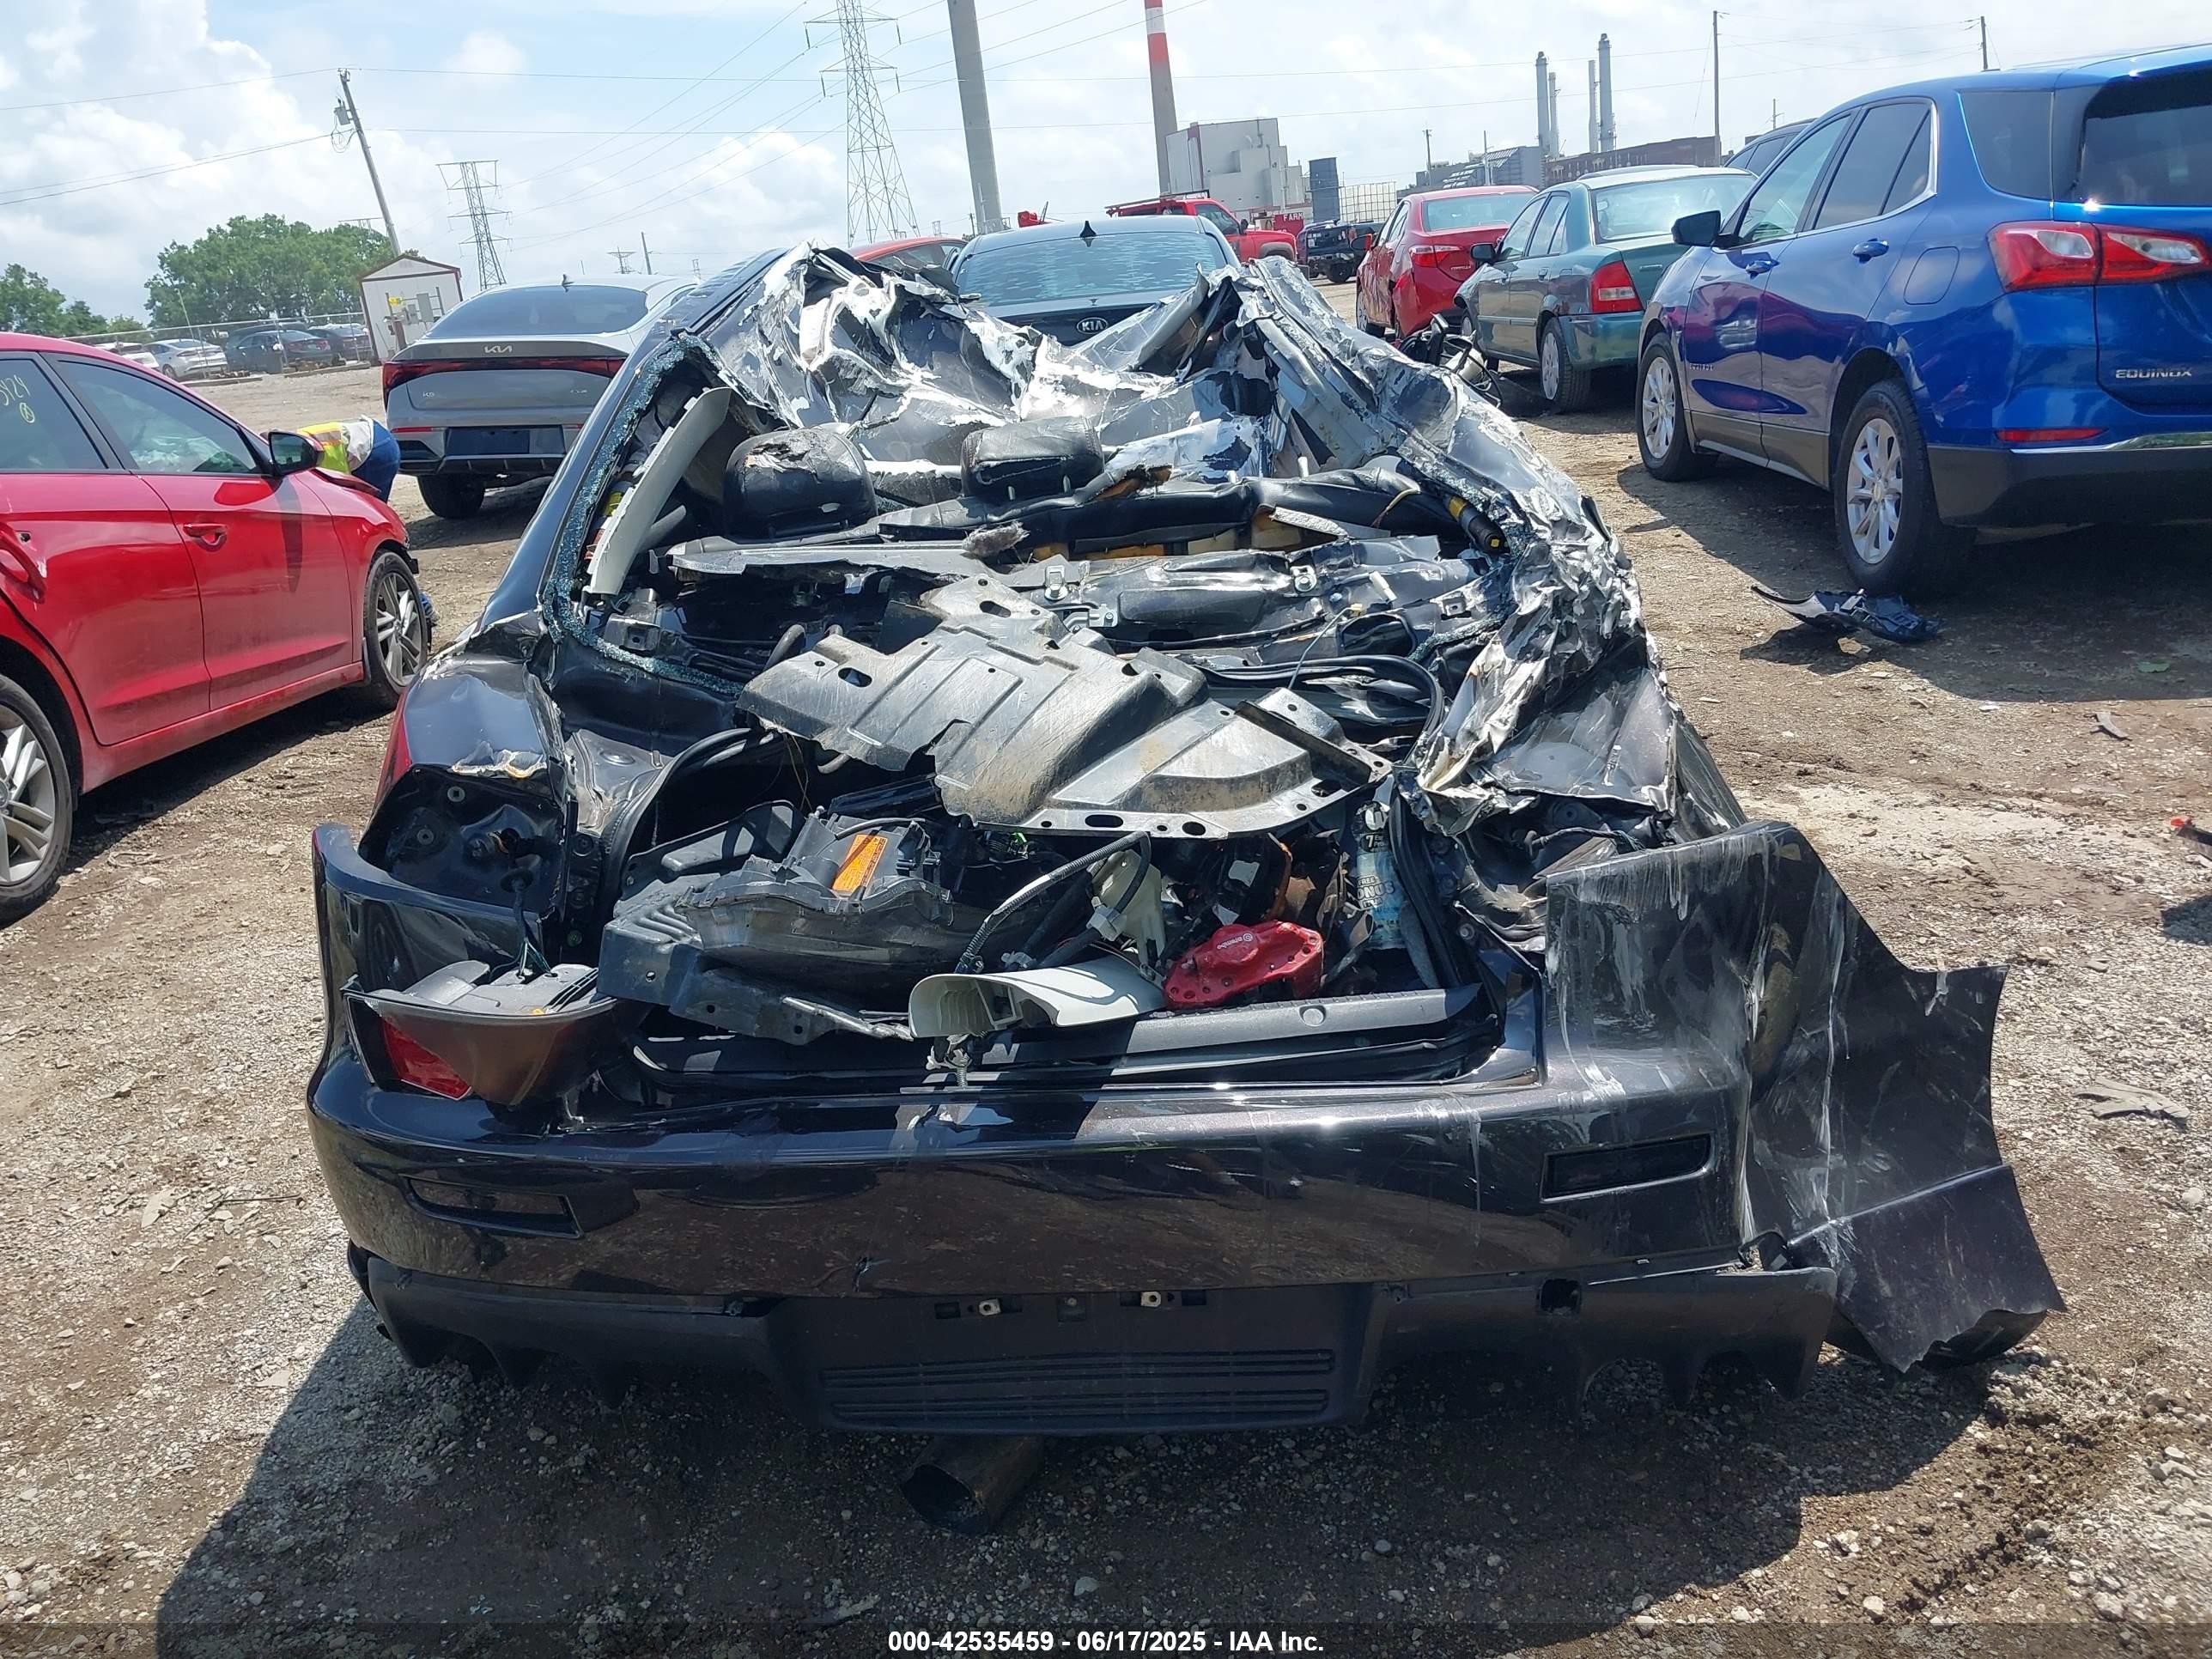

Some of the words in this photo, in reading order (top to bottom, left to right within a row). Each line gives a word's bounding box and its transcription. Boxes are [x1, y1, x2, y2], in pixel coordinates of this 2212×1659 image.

[1283, 212, 1304, 222] FARM
[1081, 320, 1103, 331] KIA
[2115, 367, 2192, 379] EQUINOX
[1358, 876, 1376, 886] FREE
[1358, 881, 1395, 900] ONUS
